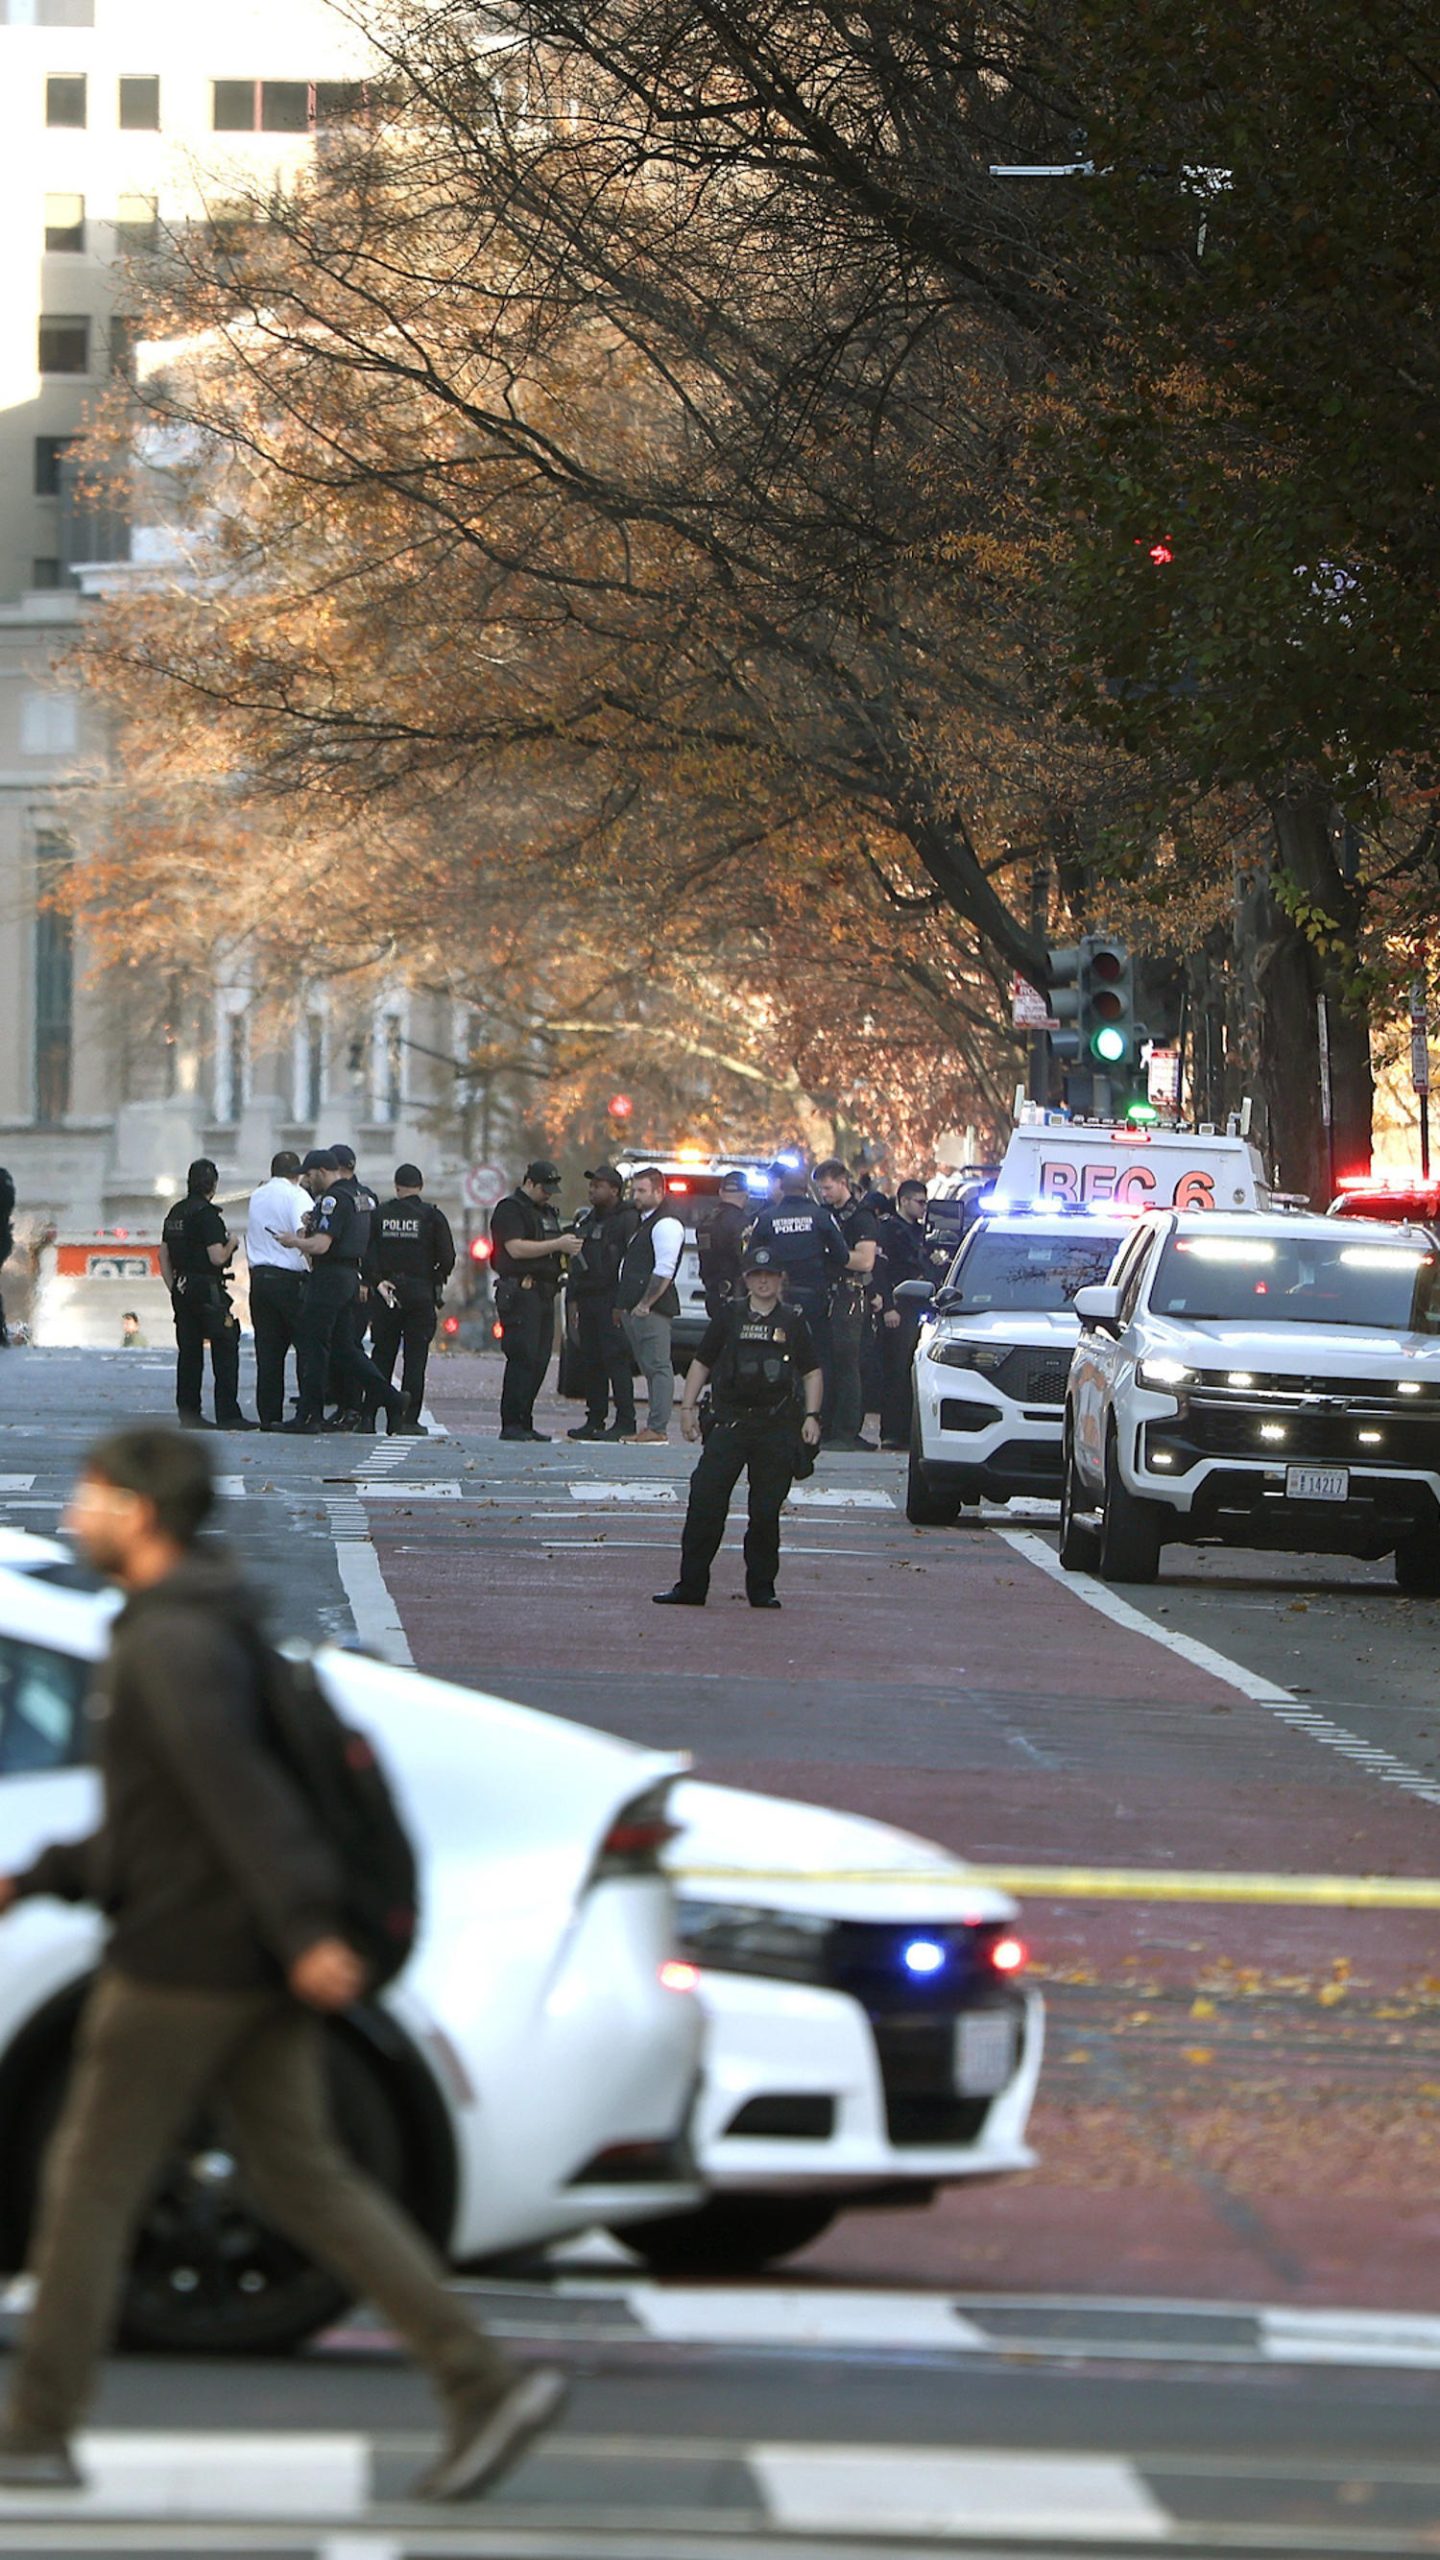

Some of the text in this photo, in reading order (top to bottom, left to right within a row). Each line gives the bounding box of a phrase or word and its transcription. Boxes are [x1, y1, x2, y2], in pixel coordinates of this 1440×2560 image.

[1173, 1170, 1216, 1210] 6
[382, 1219, 419, 1231] POLICE
[774, 1222, 813, 1235] POLICE
[742, 1323, 768, 1333] SECRET
[740, 1332, 769, 1341] SERVICE
[1309, 1476, 1343, 1494] 14217
